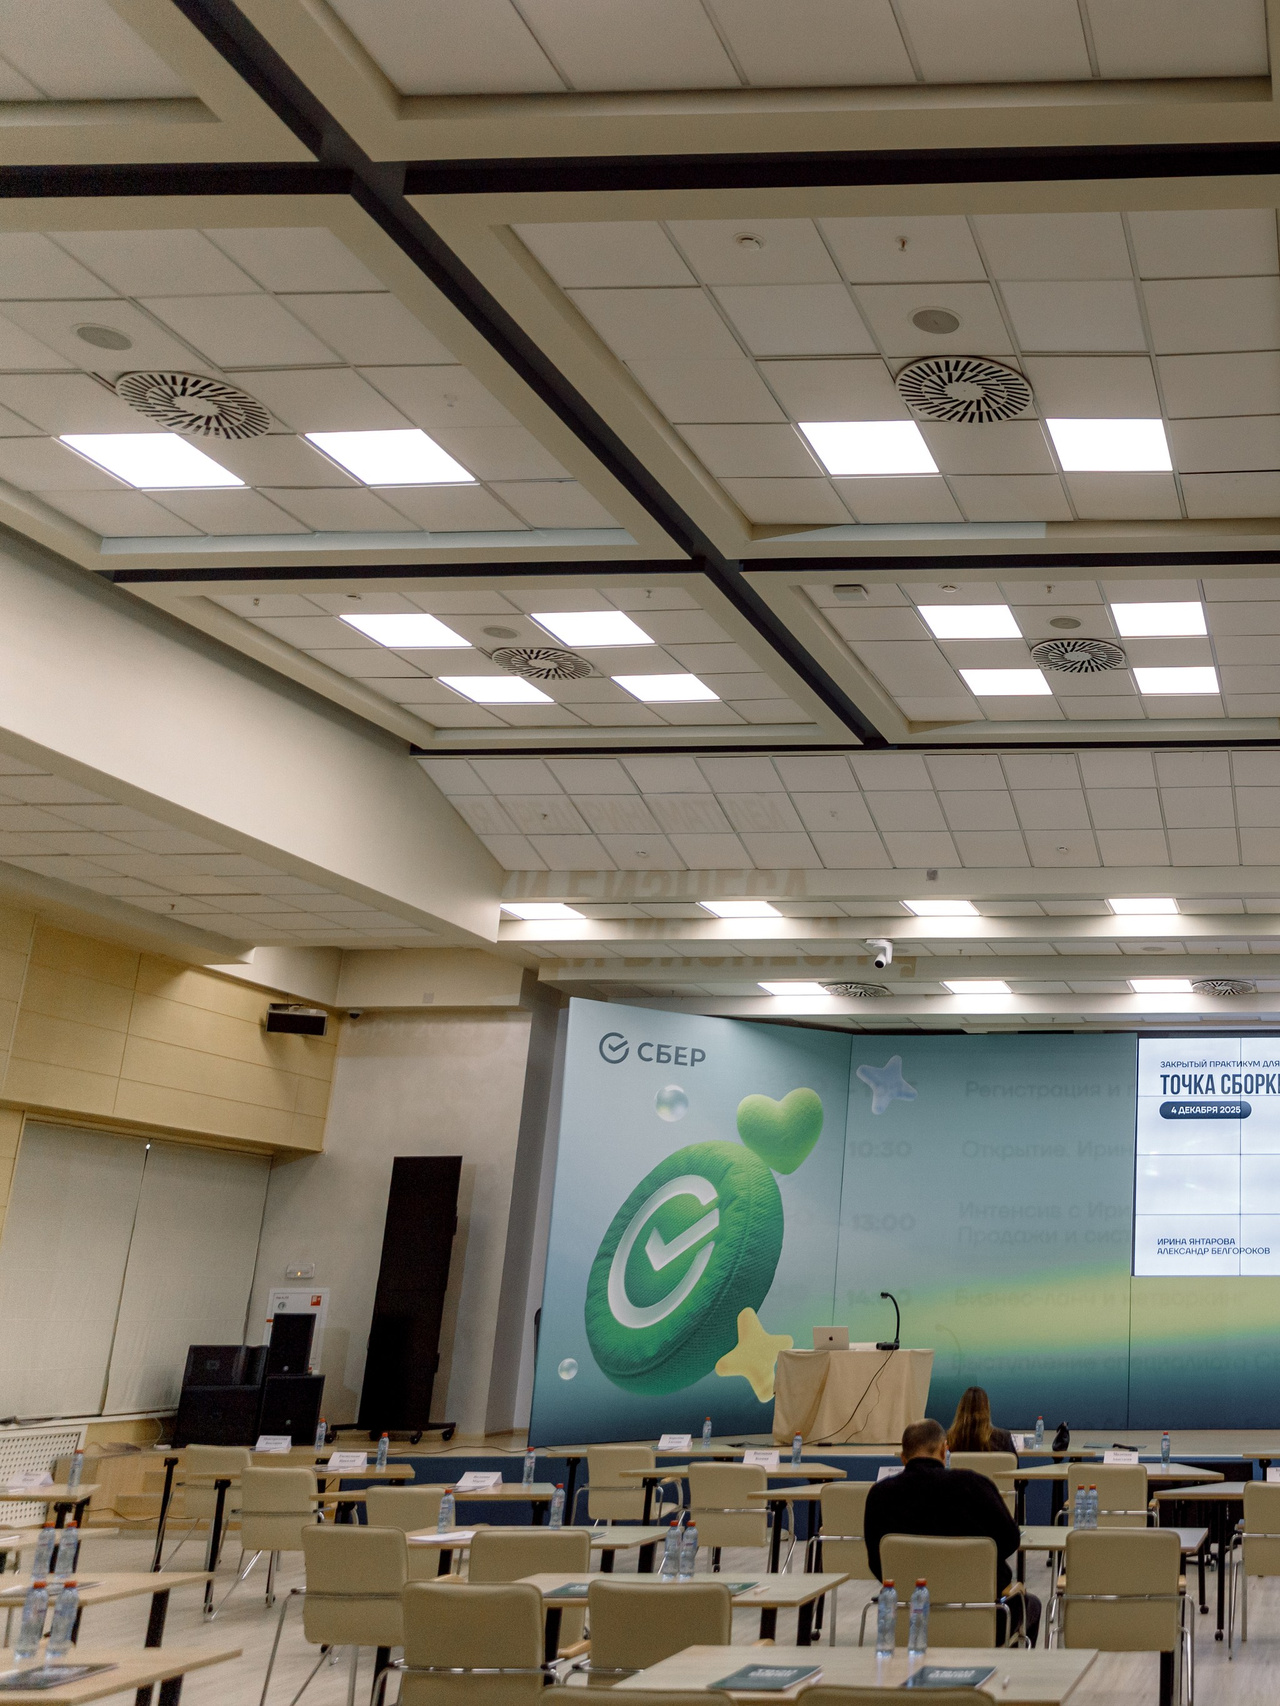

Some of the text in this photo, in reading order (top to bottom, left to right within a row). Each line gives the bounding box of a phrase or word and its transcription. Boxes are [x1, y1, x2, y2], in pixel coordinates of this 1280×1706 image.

[637, 1041, 706, 1068] СБЕР
[1160, 1060, 1207, 1068] ЗАКРЫТЫЙ
[1209, 1060, 1261, 1068] ПРАКТИКУМ
[1262, 1060, 1280, 1068] ДЛЯ
[1160, 1074, 1216, 1095] ТОЧКА
[1170, 1106, 1242, 1115] 4 ДЕКАБРЯ 2025
[1157, 1247, 1270, 1256] АЛЕКСАНДР БЕЛГОРОКОВ
